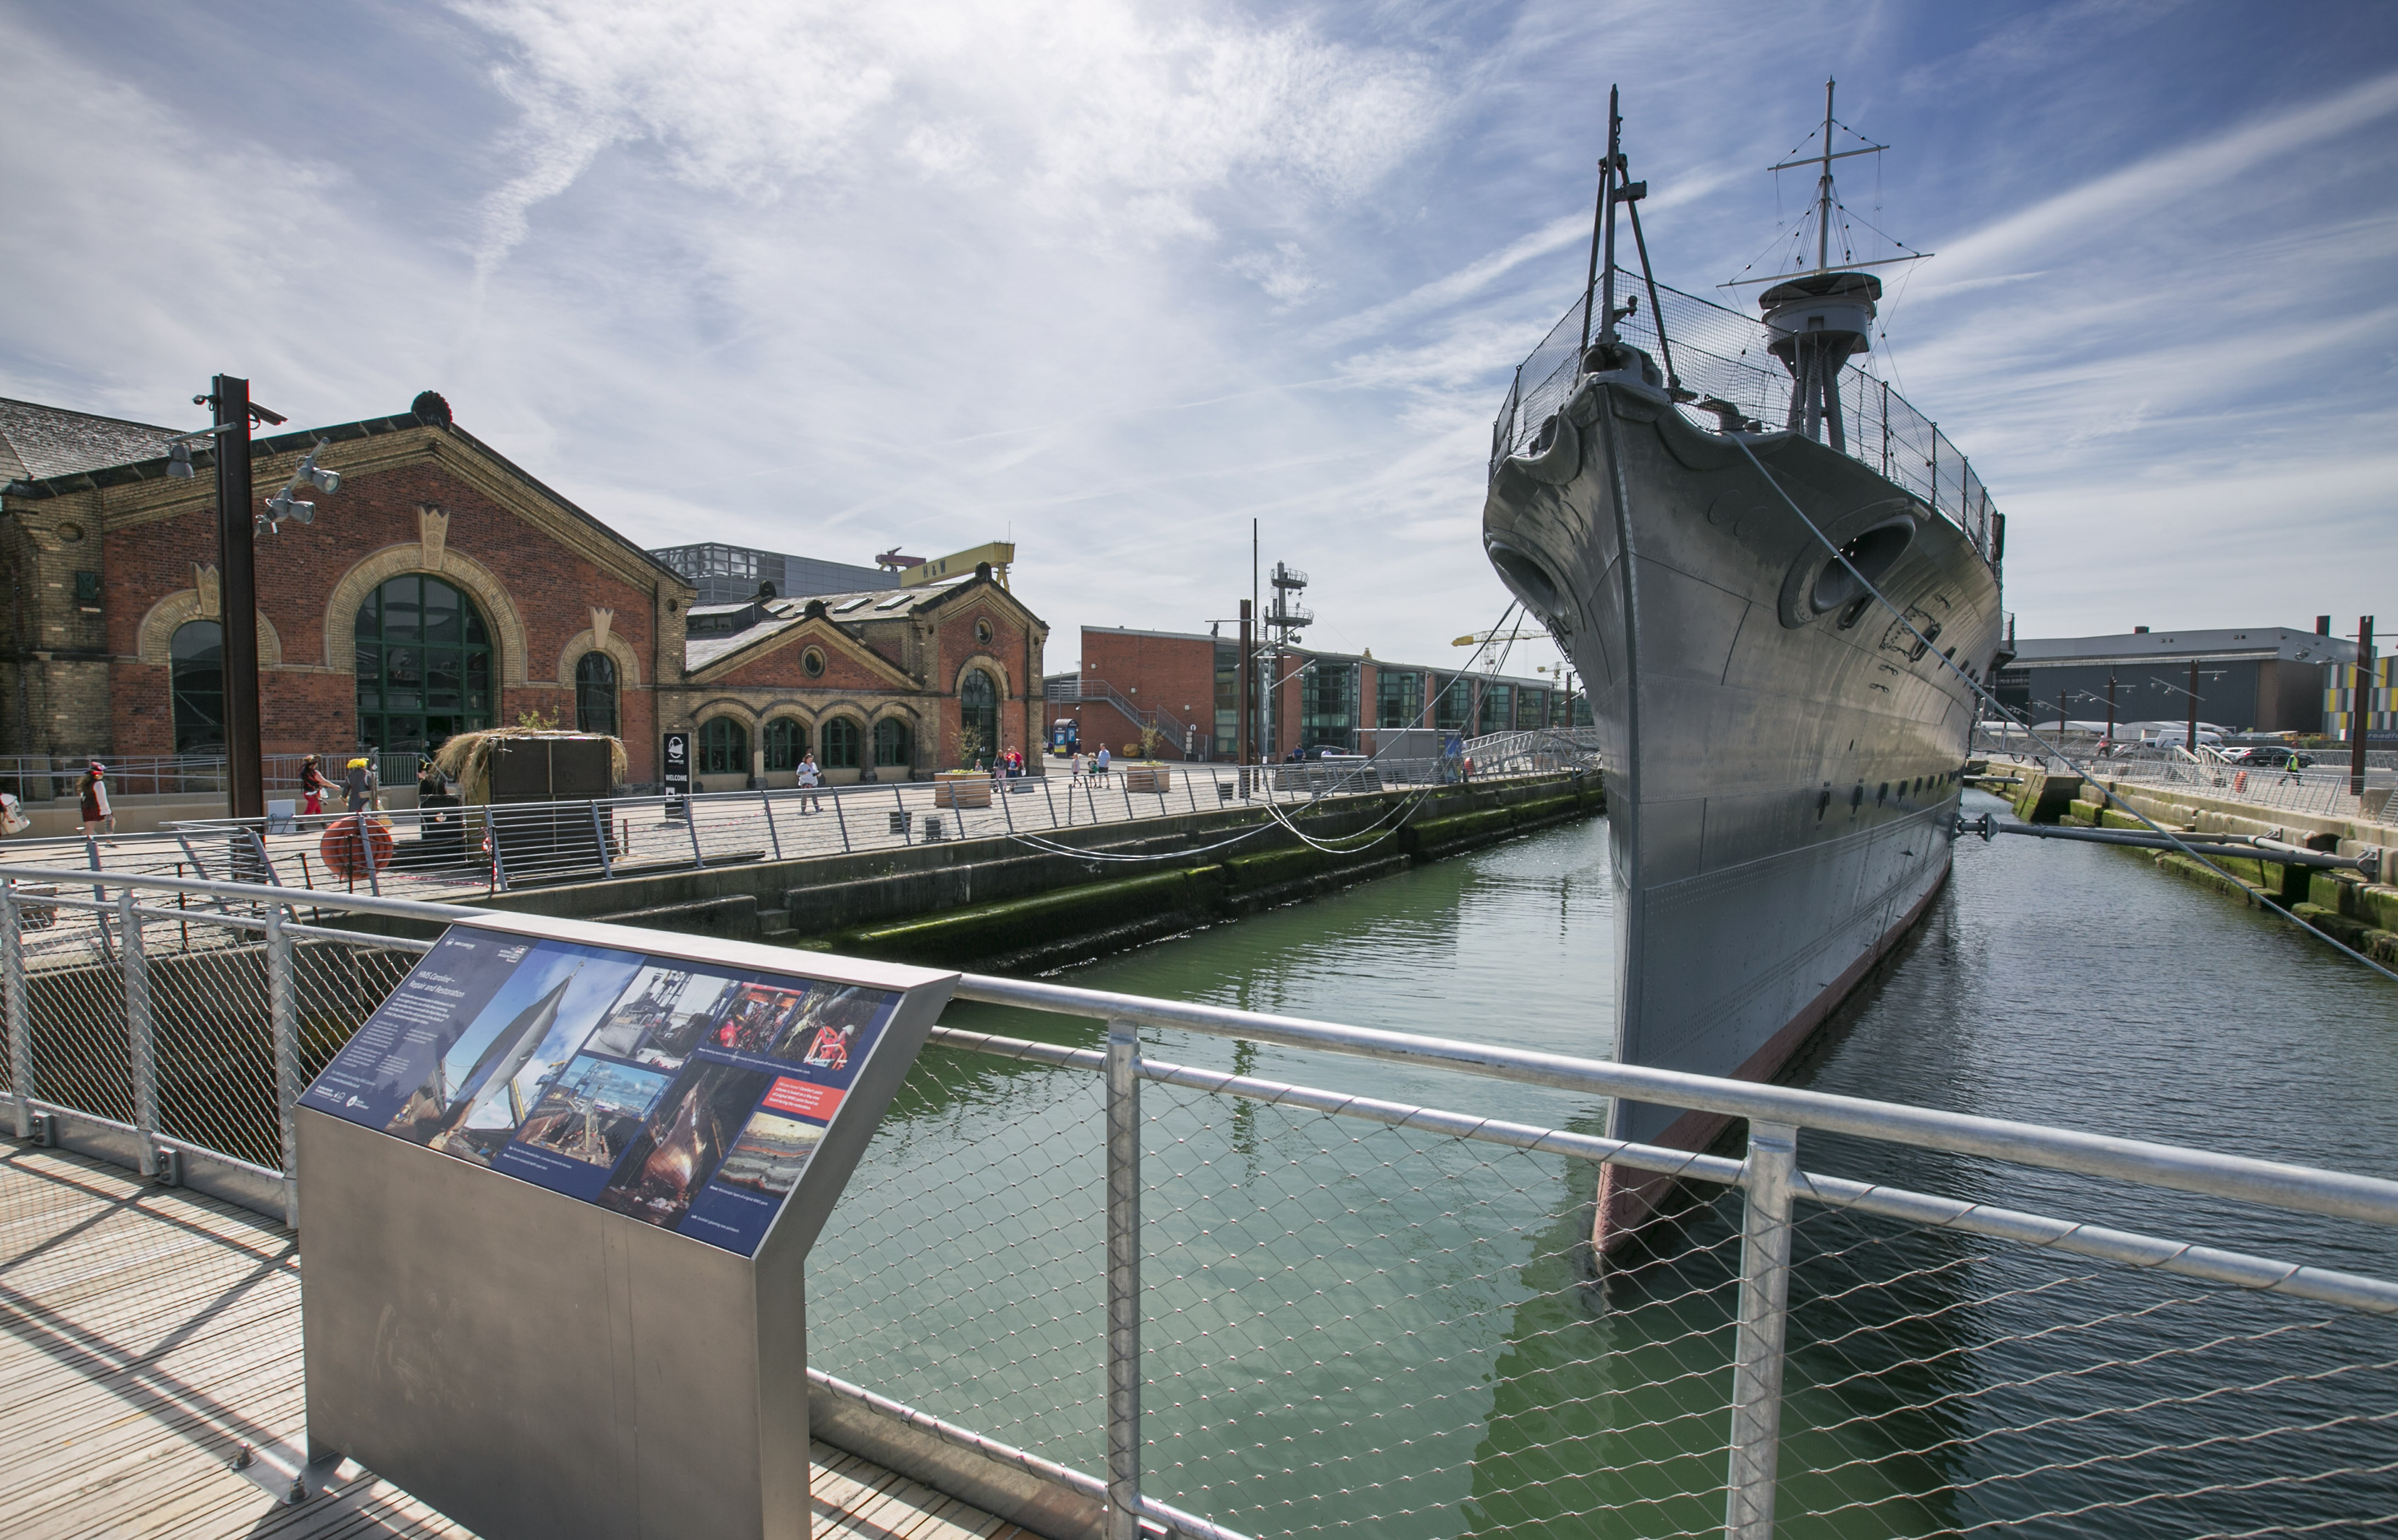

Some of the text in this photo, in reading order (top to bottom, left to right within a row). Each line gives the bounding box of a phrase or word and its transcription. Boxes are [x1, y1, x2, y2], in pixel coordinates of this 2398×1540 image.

[923, 560, 945, 578] H & W
[1057, 735, 1063, 743] P
[1069, 730, 1074, 740] P
[430, 973, 451, 983] Caroline
[409, 980, 426, 989] Repair
[435, 986, 464, 997] Restoration
